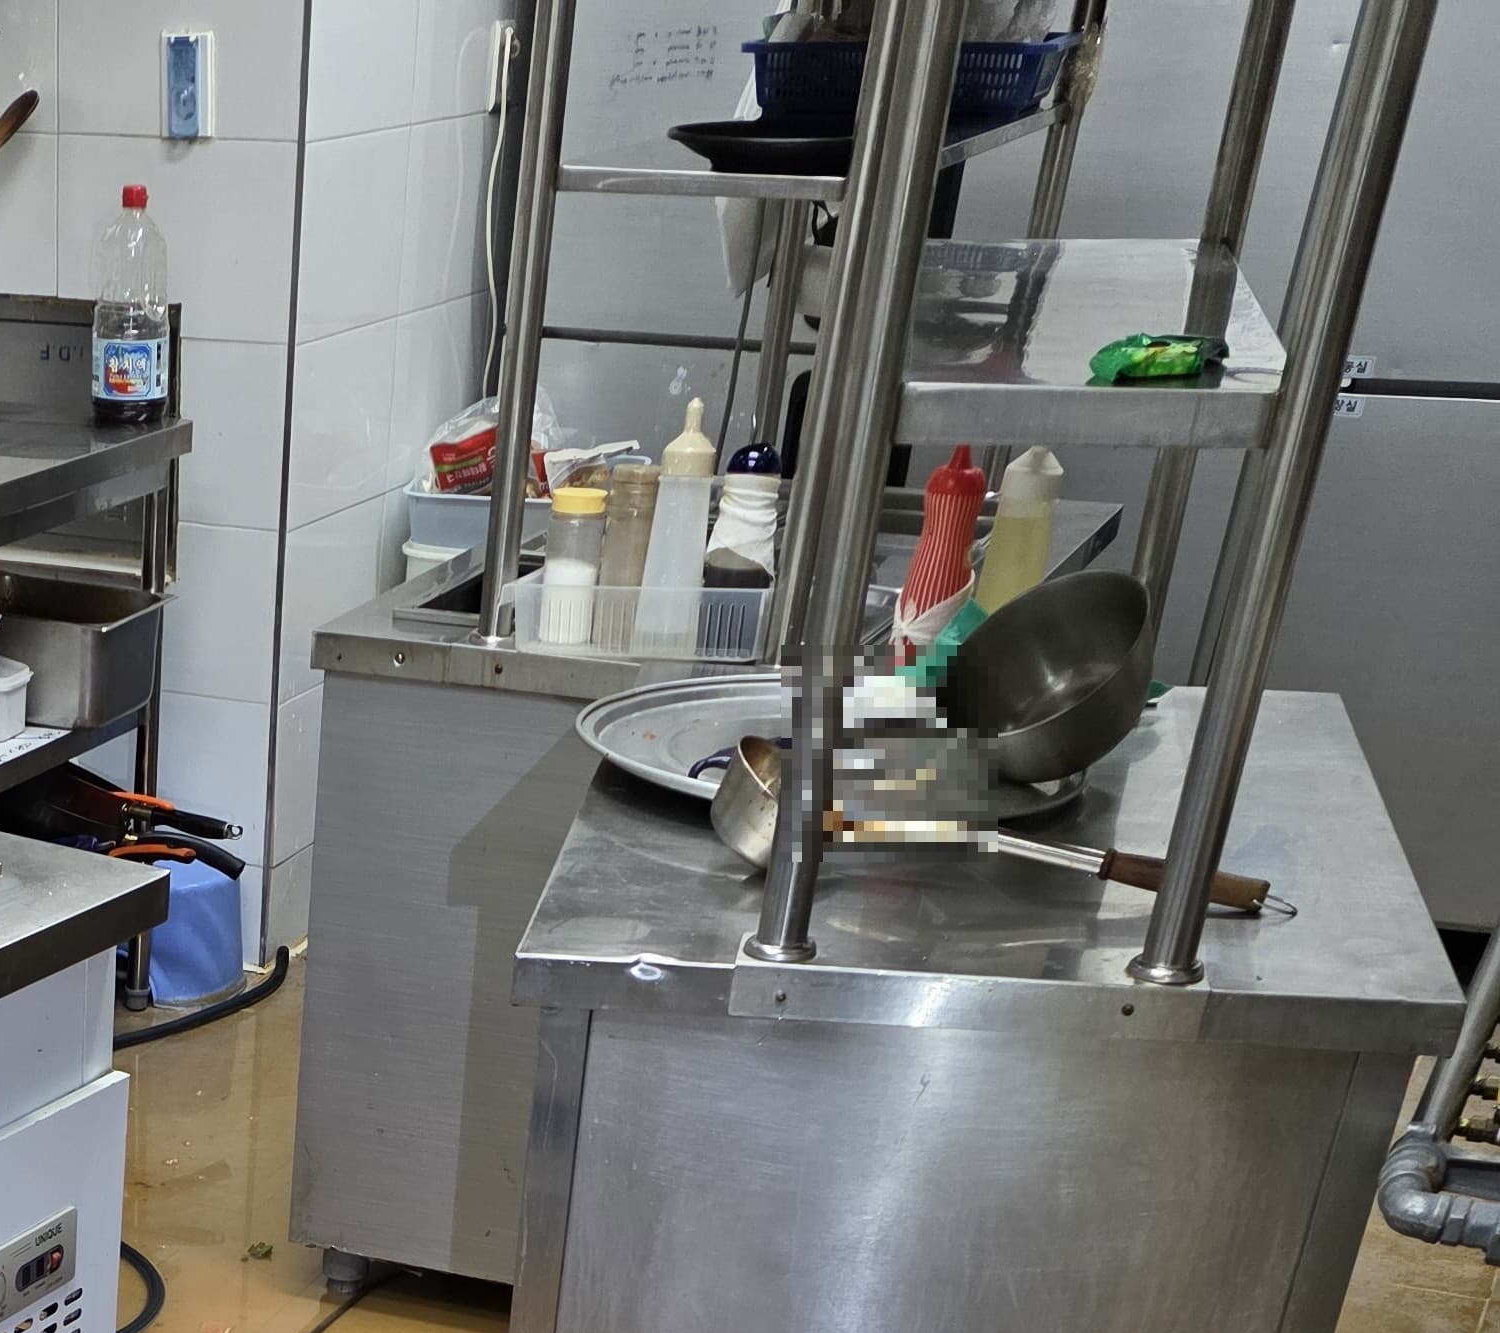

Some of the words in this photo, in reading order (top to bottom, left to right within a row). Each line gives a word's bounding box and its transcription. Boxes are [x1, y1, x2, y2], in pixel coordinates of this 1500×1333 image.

[109, 355, 147, 373] 참치액
[1344, 360, 1368, 374] 동실
[1335, 399, 1358, 412] 장실
[34, 1222, 63, 1247] UNIQUE
